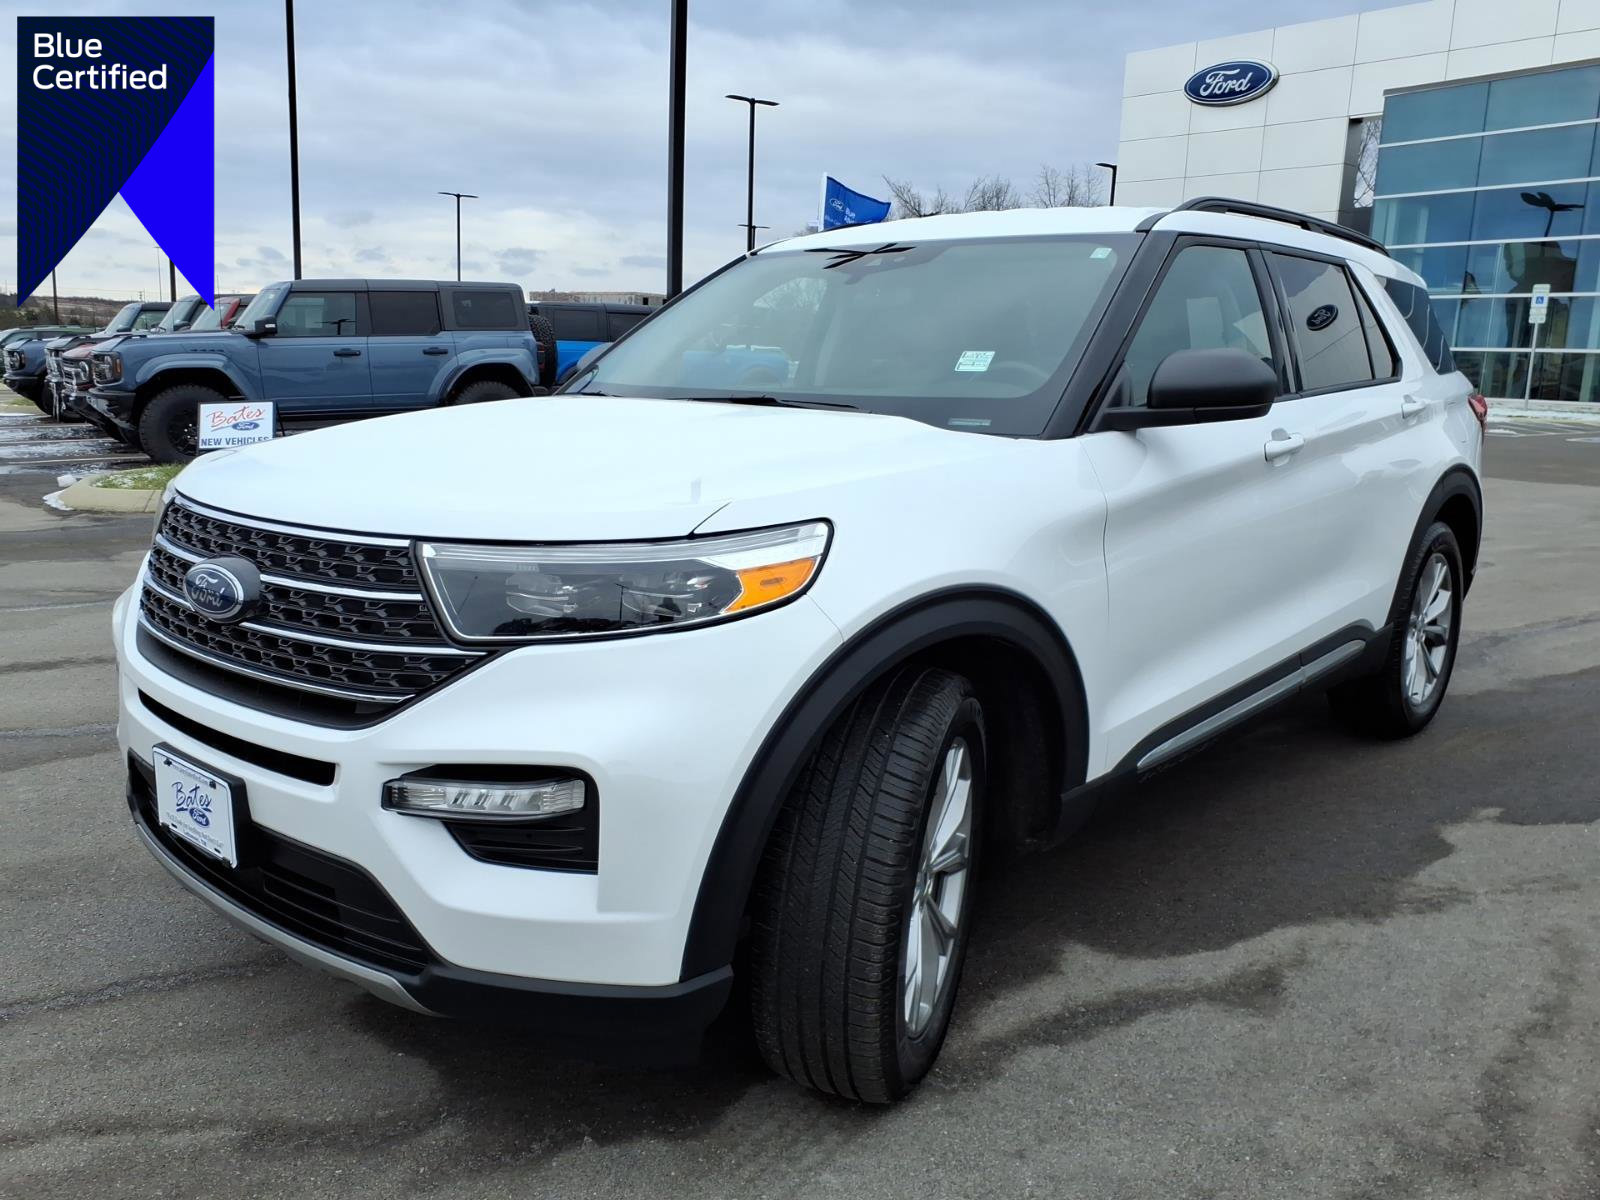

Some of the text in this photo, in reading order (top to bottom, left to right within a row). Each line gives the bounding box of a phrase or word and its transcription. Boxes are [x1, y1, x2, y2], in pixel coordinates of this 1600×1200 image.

[1200, 68, 1253, 97] Ford
[206, 406, 265, 427] Bates
[235, 421, 257, 430] Ford
[201, 438, 222, 446] NEW
[191, 573, 225, 607] Ford
[171, 782, 212, 807] Bates
[191, 808, 208, 825] Ford
